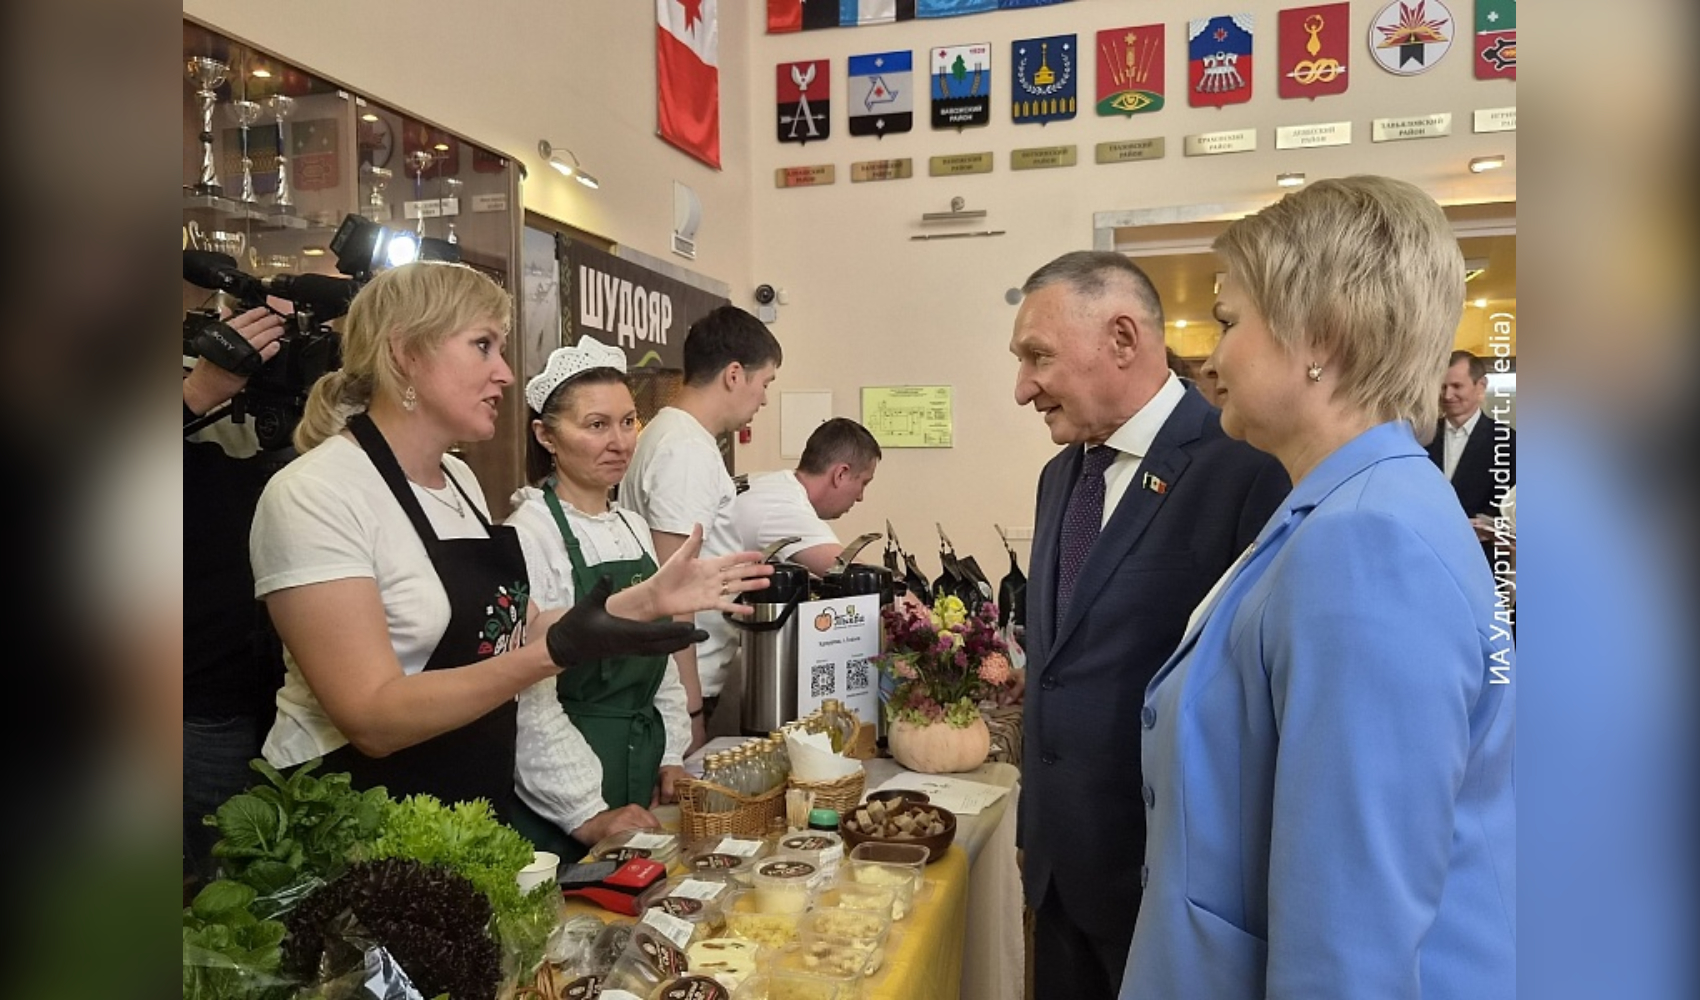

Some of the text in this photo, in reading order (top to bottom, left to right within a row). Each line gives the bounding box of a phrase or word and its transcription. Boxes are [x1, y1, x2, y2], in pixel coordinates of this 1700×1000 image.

[940, 105, 982, 116] ВАВОЖСКИЙ
[949, 114, 973, 123] РАЙОН
[1398, 128, 1425, 136] РАЙОН
[1209, 142, 1232, 151] РАЙОН
[1119, 151, 1143, 159] РАЙОН
[579, 264, 672, 349] ШУДОЯР
